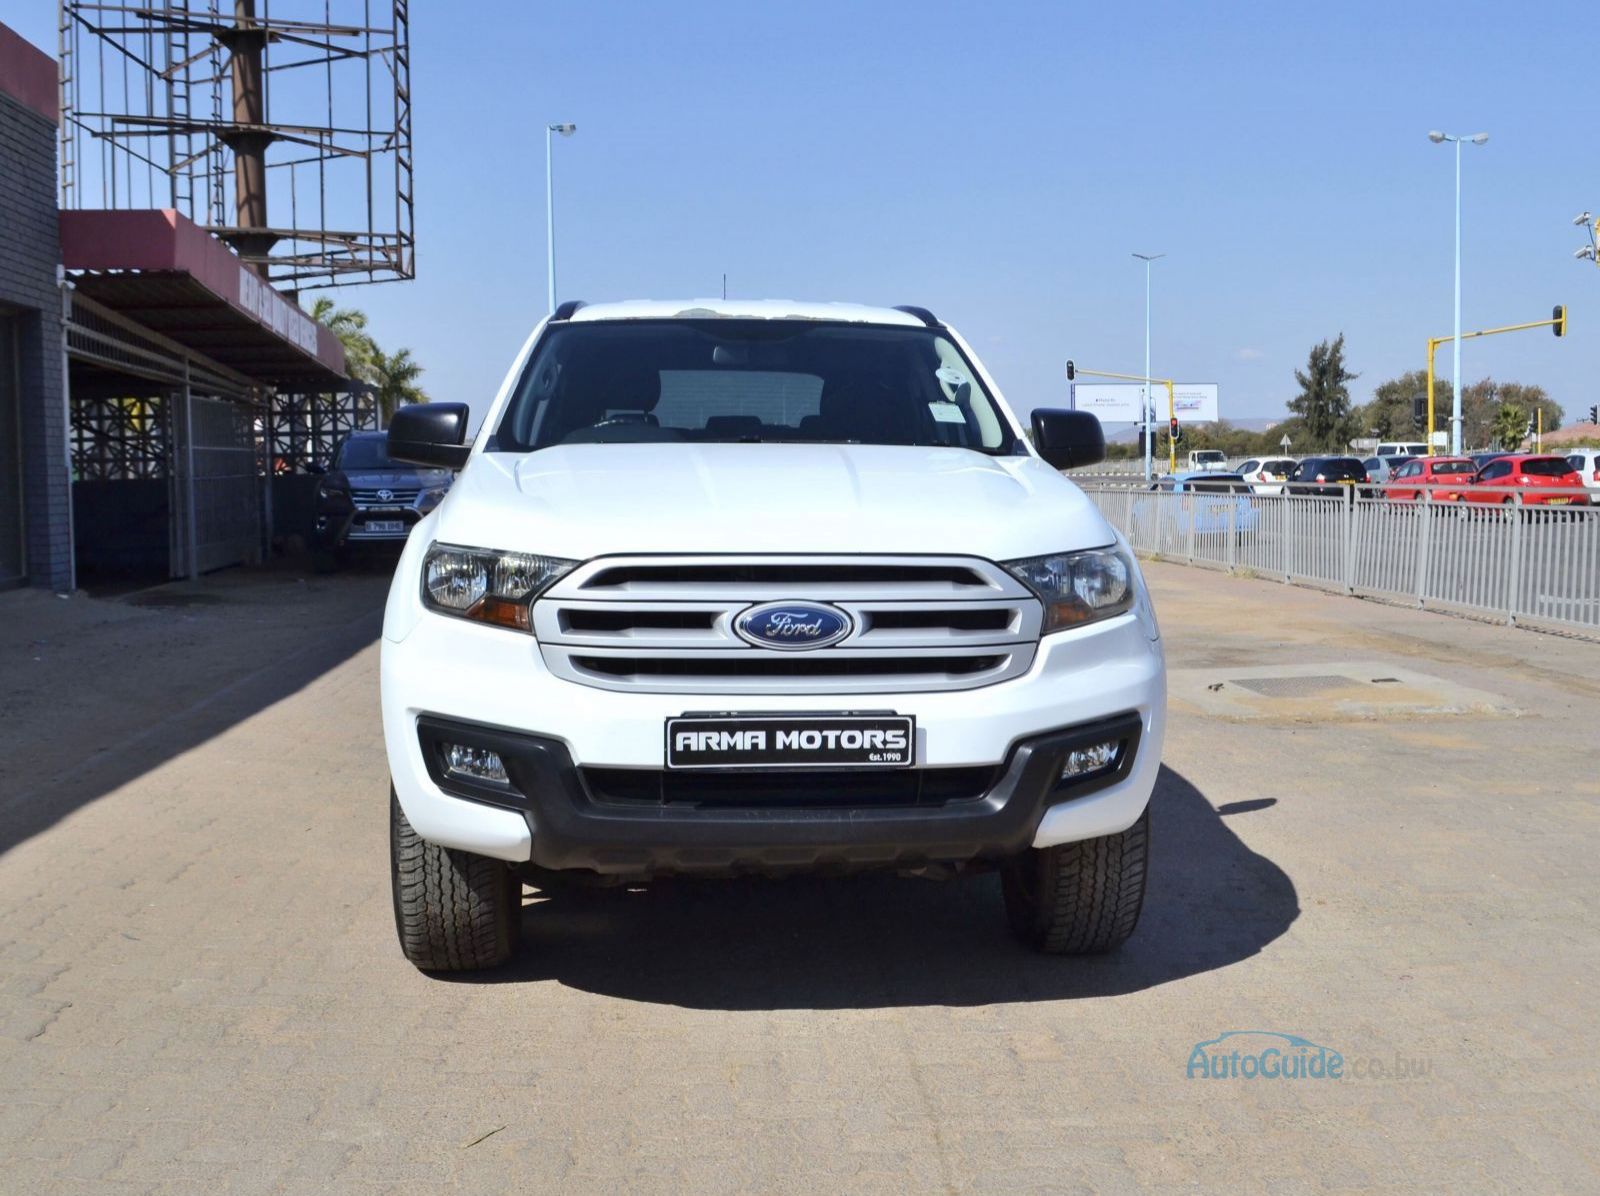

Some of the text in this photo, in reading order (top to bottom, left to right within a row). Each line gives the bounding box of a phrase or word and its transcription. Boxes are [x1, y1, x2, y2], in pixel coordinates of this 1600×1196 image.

[766, 612, 822, 636] Ford
[676, 730, 907, 751] ARMA MOTORS
